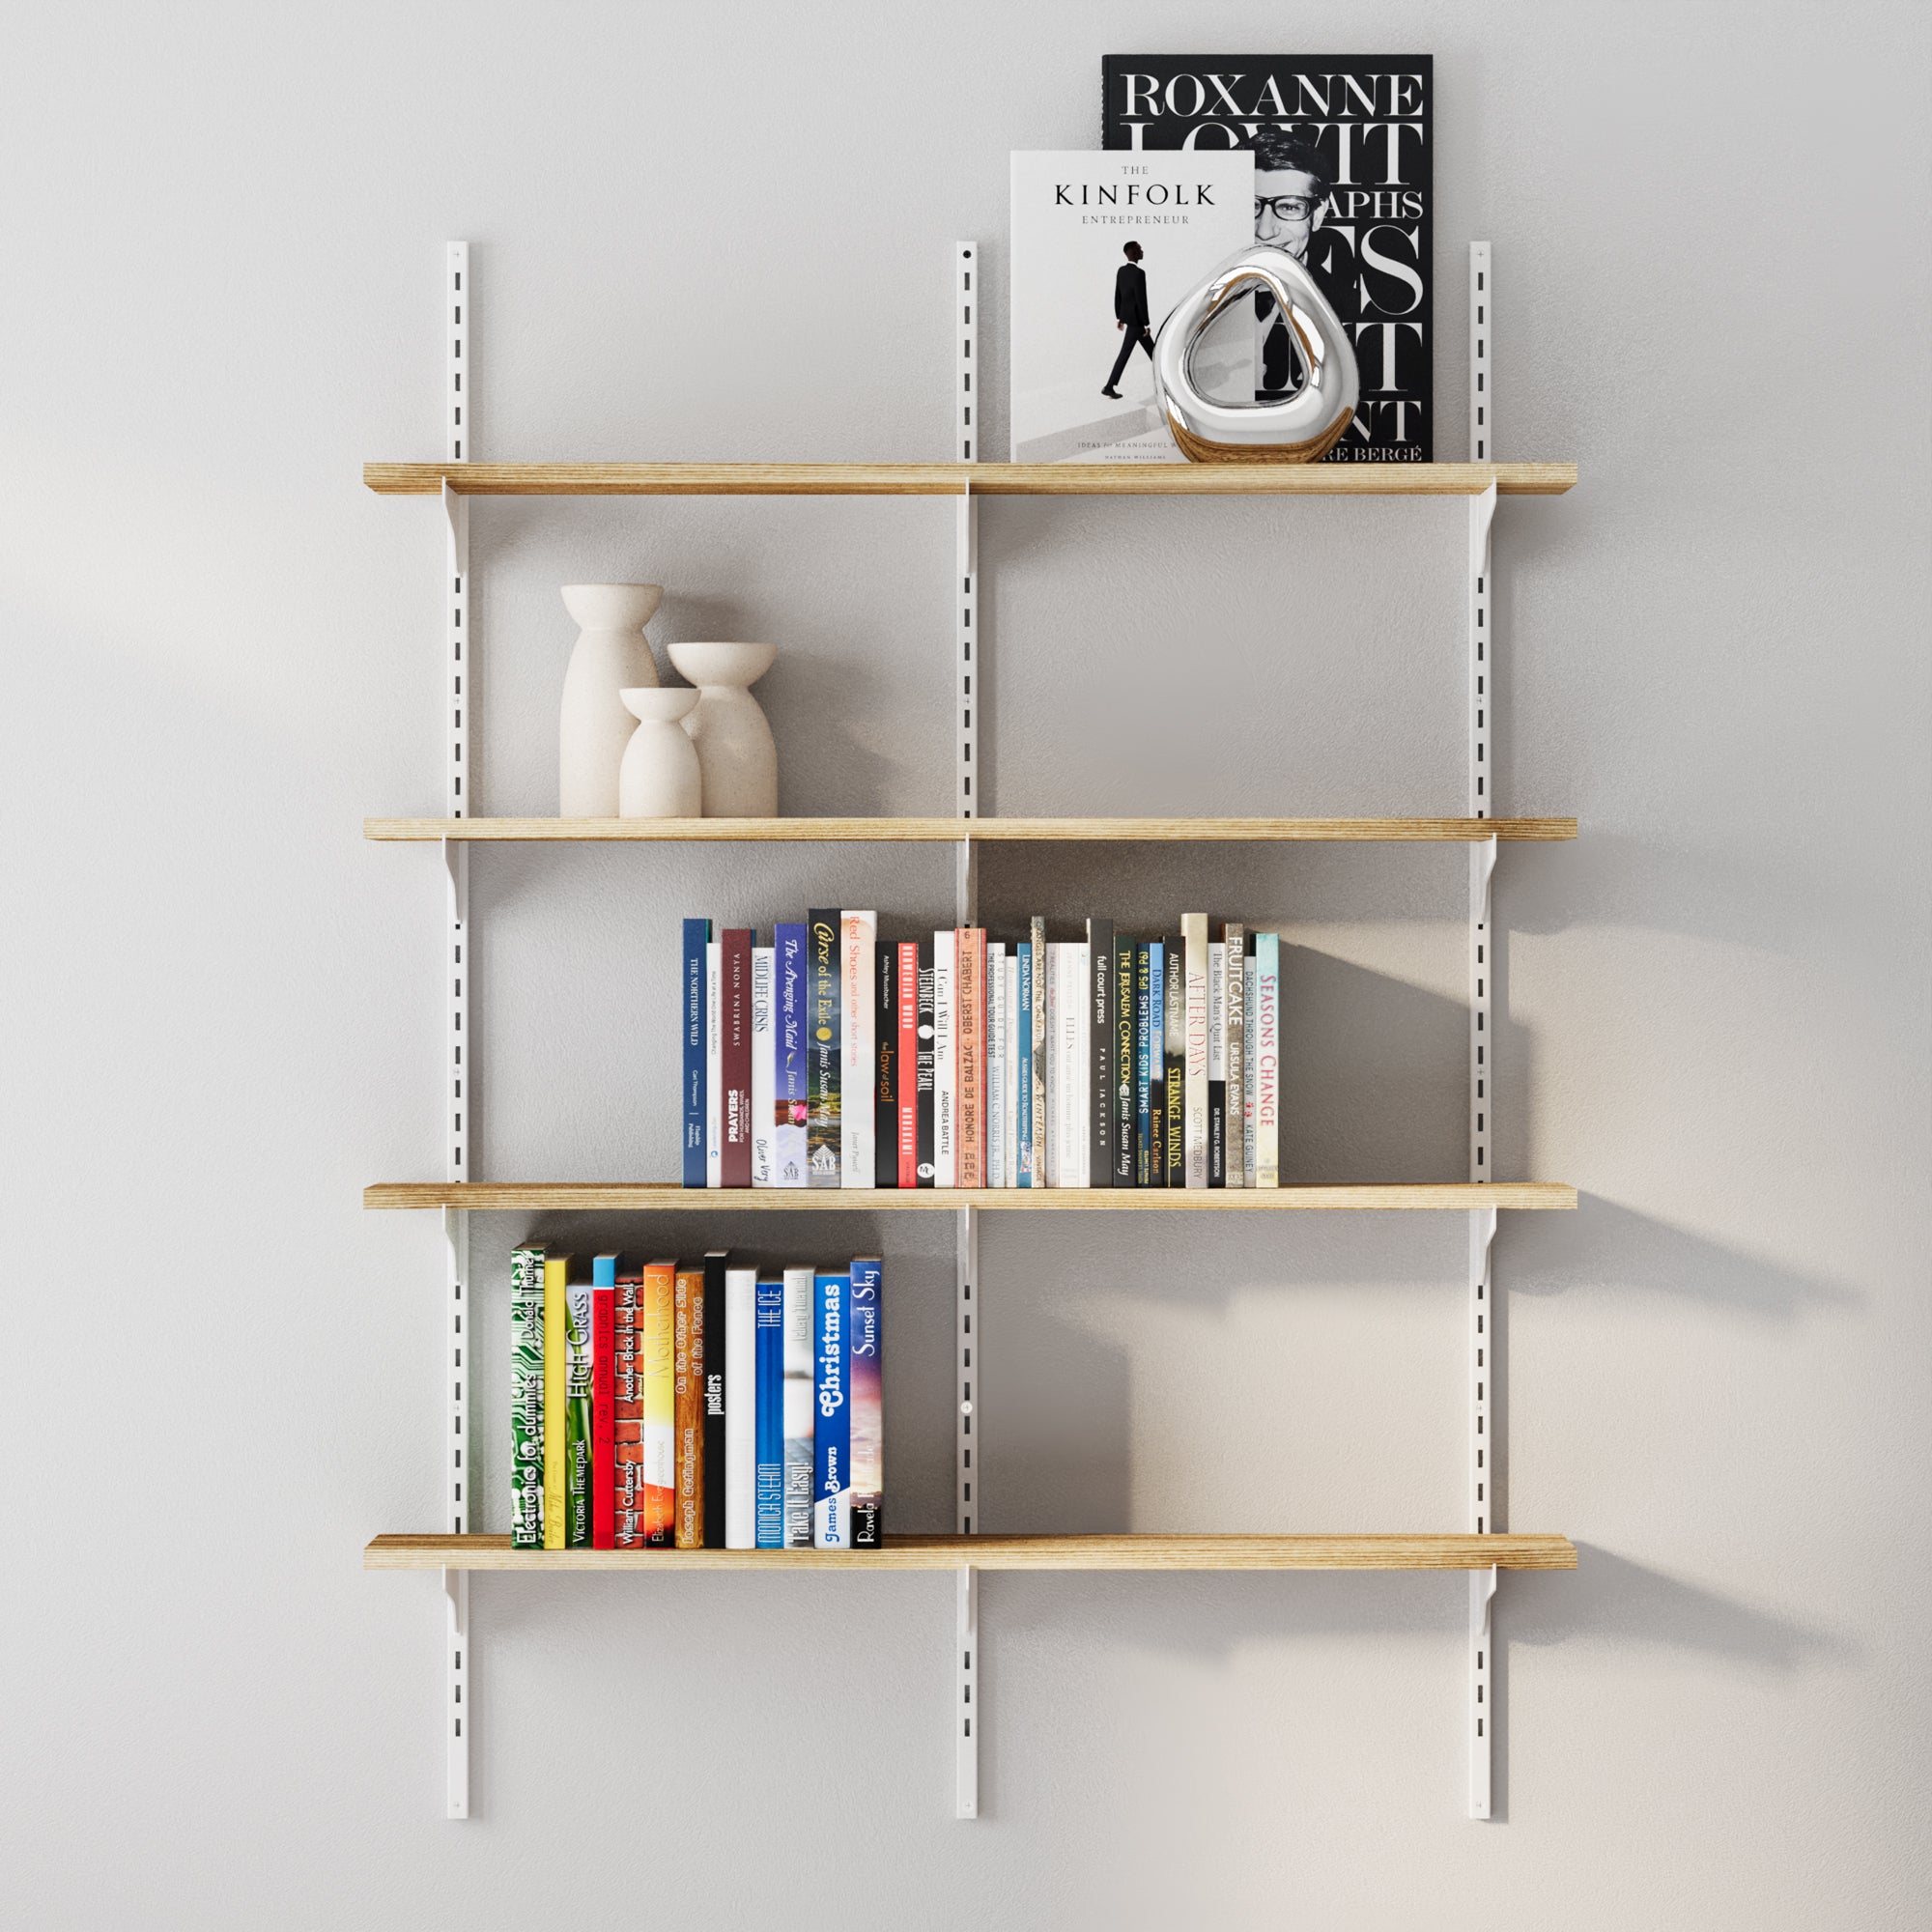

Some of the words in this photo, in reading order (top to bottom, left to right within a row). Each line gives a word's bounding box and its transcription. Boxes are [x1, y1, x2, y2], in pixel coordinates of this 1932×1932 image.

[1120, 73, 1423, 117] ROXANNE
[1121, 165, 1149, 175] THE
[1055, 184, 1216, 206] KINFOLK
[1082, 215, 1189, 224] ENTREPRENEUR
[1354, 445, 1423, 462] BERGÉ
[849, 916, 860, 940] Red
[784, 939, 799, 958] The
[813, 923, 835, 965] Curse
[818, 965, 832, 978] of
[849, 945, 860, 980] Shoes
[902, 946, 913, 999] NORWEGIAN
[962, 951, 973, 995] CHABERT
[1022, 953, 1031, 977] LINDA
[1097, 955, 1107, 971] full
[1119, 950, 1131, 969] THE
[1169, 952, 1179, 990] AUTHOR
[1212, 951, 1223, 968] The
[754, 954, 769, 998] MIDLIFE
[782, 960, 798, 1013] Avenging
[818, 980, 832, 996] the
[850, 982, 860, 997] and
[919, 968, 935, 1013] STEINBECK
[1096, 972, 1106, 997] court
[1152, 969, 1162, 997] DARK
[1212, 970, 1223, 993] Black
[1228, 936, 1243, 1026] FRUITCAKE
[1118, 972, 1131, 1018] JERUSALEM
[1189, 972, 1206, 1027] AFTER
[1213, 995, 1223, 1021] Man's
[1245, 971, 1254, 1016] DACHSHUND
[753, 1000, 769, 1033] CRISIS
[818, 999, 833, 1025] Exile
[850, 999, 860, 1019] other
[902, 1005, 913, 1029] WOOD
[937, 1009, 950, 1030] Will
[962, 998, 973, 1035] OBERST
[1095, 998, 1106, 1024] press
[1139, 995, 1149, 1047] PROBLEMS
[1152, 999, 1162, 1028] ROAD
[1169, 991, 1179, 1037] LASTNAME
[1260, 975, 1277, 1047] SEASONS
[784, 1014, 798, 1050] Maid
[850, 1022, 860, 1040] short
[1209, 1022, 1223, 1042] Quit
[1245, 1019, 1254, 1056] THROUGH
[818, 1042, 831, 1068] Janis
[850, 1042, 860, 1067] stories
[880, 1050, 895, 1074] law
[918, 1050, 935, 1065] THE
[936, 1041, 948, 1060] Am
[963, 1045, 974, 1082] BALZAC
[1119, 1020, 1131, 1085] CONNECTION
[1189, 1033, 1206, 1076] DAYS
[1213, 1045, 1223, 1062] List
[1230, 1041, 1239, 1081] URSULA
[1245, 1058, 1254, 1071] THE
[785, 1069, 798, 1095] Janis
[819, 1070, 831, 1100] Susan
[880, 1081, 895, 1102] soil
[918, 1068, 935, 1093] PEARL
[964, 1087, 975, 1099] DE
[991, 1065, 1000, 1101] WILLIAM
[1169, 1067, 1181, 1120] STRANGE
[1245, 1073, 1254, 1096] SNOW
[1260, 1055, 1277, 1126] CHANGE
[941, 1091, 950, 1124] ANDREA
[1120, 1096, 1131, 1121] Janis
[1139, 1080, 1149, 1114] SMART
[1230, 1084, 1239, 1116] EVANS
[728, 1090, 739, 1143] PRAYERS
[814, 1102, 831, 1127] May
[991, 1111, 1000, 1143] NORRIS
[1193, 1106, 1203, 1134] SCOTT
[902, 1107, 913, 1155] MURAKAMI
[941, 1125, 950, 1155] BATTLE
[1121, 1122, 1131, 1151] Susan
[1245, 1124, 1254, 1143] KATE
[755, 1139, 768, 1162] Oliver
[1152, 1140, 1162, 1175] Carlson
[1169, 1126, 1181, 1168] WINDS
[1193, 1136, 1203, 1179] MEDBURY
[1245, 1145, 1254, 1173] GUINEY
[753, 1165, 771, 1181] Very
[812, 1156, 837, 1171] SAB
[1117, 1152, 1131, 1176] May
[623, 1284, 634, 1306] Wall
[675, 1278, 687, 1308] Side
[757, 1290, 781, 1306] ICE
[852, 1270, 880, 1301] Sky
[520, 1300, 534, 1339] Donald
[598, 1294, 611, 1350] graphics
[623, 1307, 634, 1323] the
[623, 1325, 634, 1334] in
[645, 1274, 670, 1378] Motherhood
[691, 1296, 703, 1335] Fence
[757, 1309, 781, 1329] THE
[675, 1311, 687, 1350] Other
[852, 1306, 875, 1357] Sunset
[622, 1336, 634, 1361] Brick
[675, 1351, 687, 1374] the
[691, 1338, 703, 1359] the
[818, 1284, 843, 1417] Christmas
[598, 1355, 611, 1395] annual
[622, 1362, 634, 1403] Another
[691, 1361, 703, 1377] of
[674, 1377, 687, 1394] On
[703, 1374, 725, 1415] posters
[517, 1374, 536, 1435] dummies
[598, 1404, 609, 1429] rev.
[516, 1441, 536, 1461] for
[622, 1459, 637, 1507] Cuttersby
[757, 1463, 781, 1500] STEAM
[785, 1462, 813, 1495] Easy!
[824, 1446, 840, 1493] Brown
[517, 1466, 537, 1544] Electronics
[785, 1498, 810, 1509] It
[622, 1508, 634, 1545] William
[651, 1504, 665, 1542] Elizabeth
[682, 1500, 696, 1545] Joseph
[757, 1503, 781, 1544] MONICA
[785, 1512, 810, 1544] Take
[824, 1497, 840, 1543] James
[857, 1502, 874, 1543] Ravela
